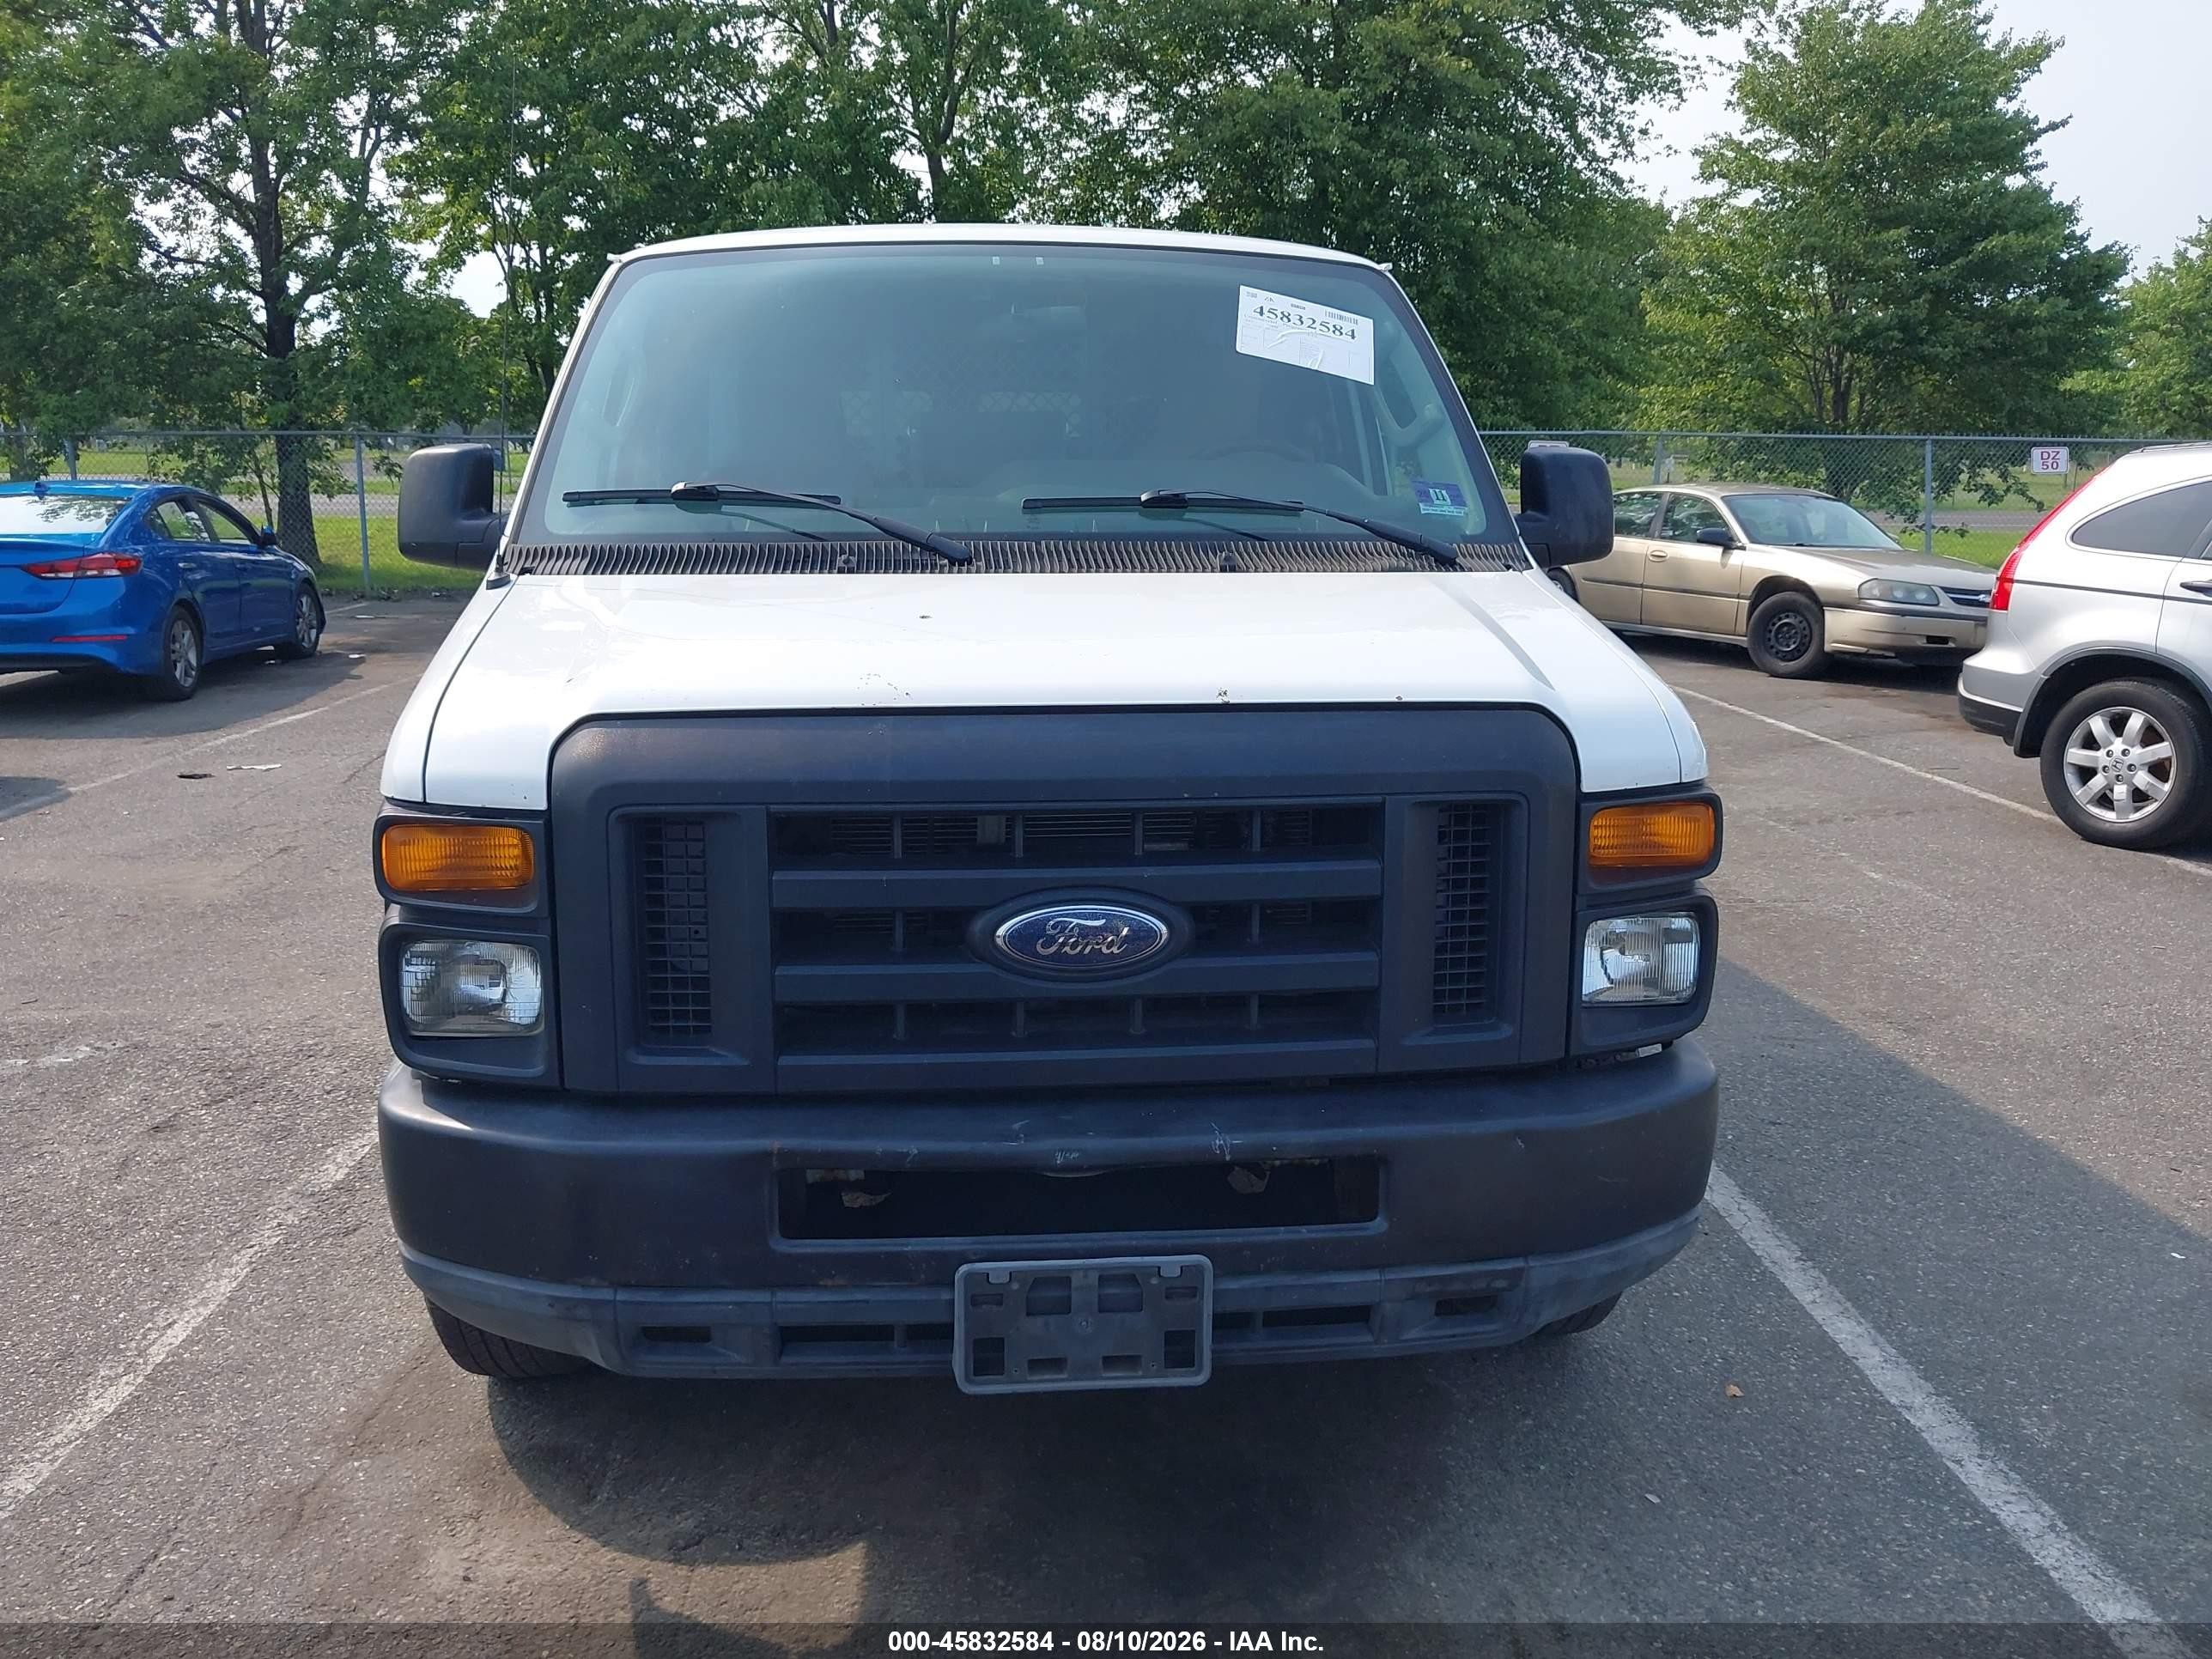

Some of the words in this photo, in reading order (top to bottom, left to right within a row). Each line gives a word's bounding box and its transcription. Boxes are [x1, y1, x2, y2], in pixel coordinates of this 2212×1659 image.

[1253, 305, 1357, 340] 45832584
[2040, 451, 2061, 460] DZ
[2041, 461, 2059, 471] 50
[1432, 489, 1448, 502] 11
[1036, 918, 1130, 956] Ford
